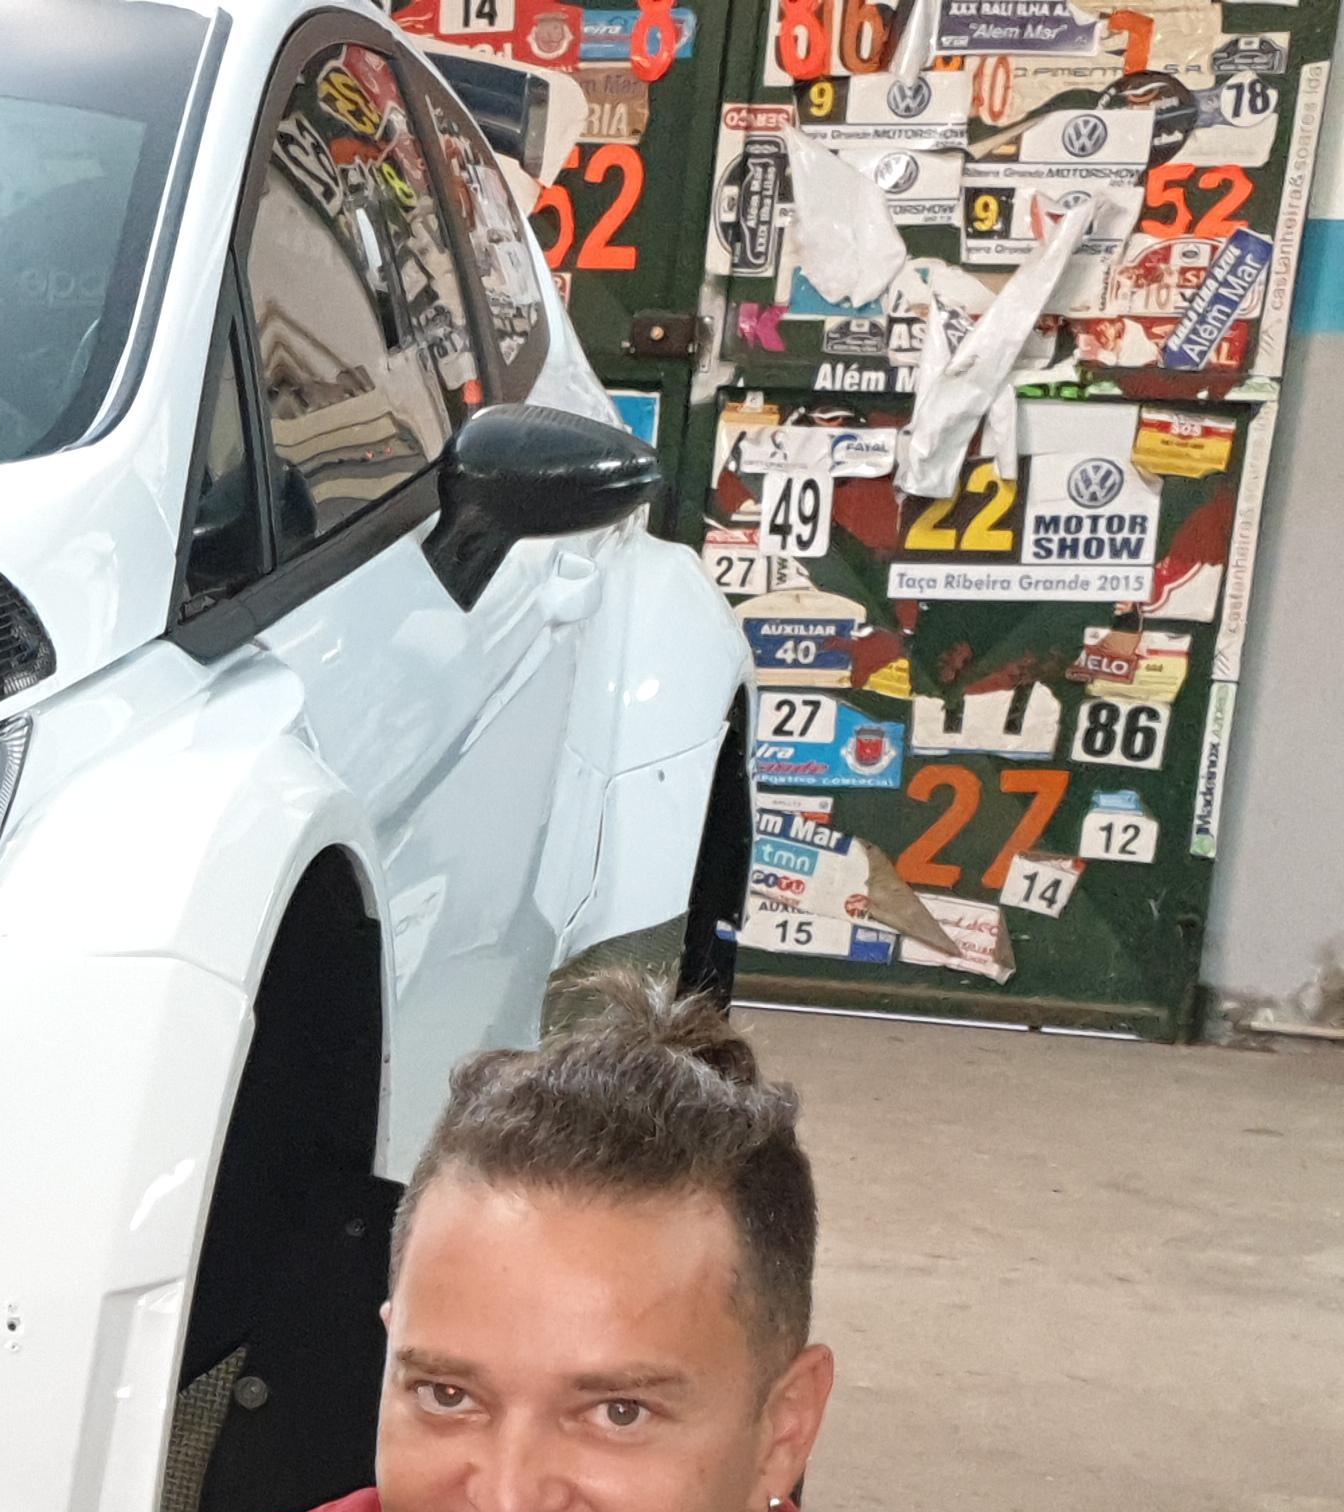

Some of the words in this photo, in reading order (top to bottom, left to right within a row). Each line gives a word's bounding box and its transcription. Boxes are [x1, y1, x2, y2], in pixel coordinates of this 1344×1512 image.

[809, 81, 836, 117] 9
[1224, 79, 1271, 119] 78
[1046, 167, 1140, 178] MOTORSHOW
[974, 194, 999, 231] 9
[1141, 162, 1254, 238] 52
[1181, 303, 1231, 364] Além
[1220, 255, 1264, 304] Mar
[815, 361, 887, 391] Além
[769, 477, 820, 551] 49
[1033, 514, 1148, 535] MOTOR
[1033, 536, 1144, 560] SHOW
[715, 555, 756, 588] 27
[897, 573, 937, 592] Taça
[943, 573, 1011, 591] Ribeira
[1018, 573, 1090, 592] Grande
[1097, 574, 1145, 592] 2015
[761, 624, 836, 636] AUXILIAR
[775, 640, 816, 664] 40
[772, 699, 821, 737] 27
[1082, 702, 1161, 762] 86
[790, 819, 842, 850] Mar
[895, 764, 1070, 888] 27
[1098, 822, 1141, 855] 12
[762, 845, 809, 872] tmn
[1022, 871, 1061, 909] 14
[776, 920, 812, 944] 15
